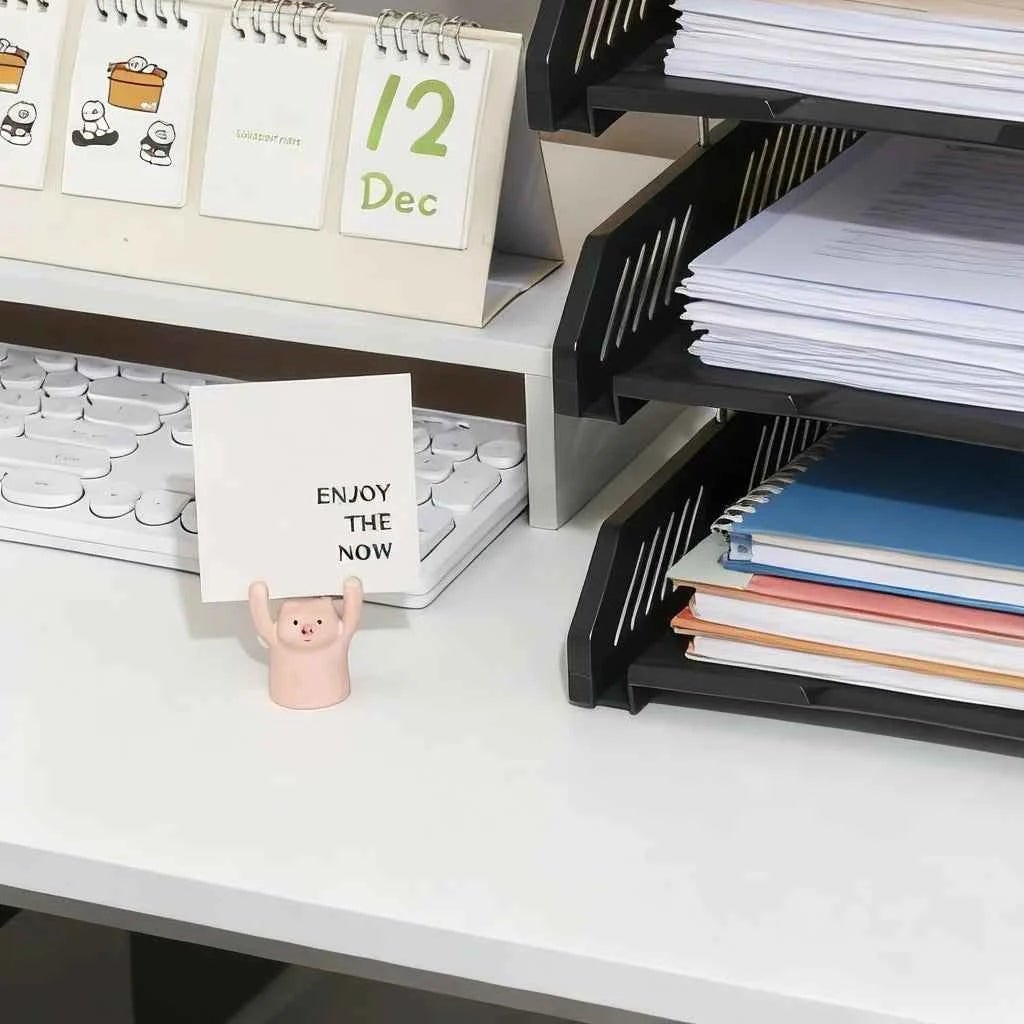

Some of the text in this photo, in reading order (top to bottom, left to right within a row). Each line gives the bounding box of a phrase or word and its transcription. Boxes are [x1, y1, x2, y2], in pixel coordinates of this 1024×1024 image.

[367, 73, 455, 157] 12
[361, 171, 438, 216] Dec
[317, 483, 391, 504] ENJOY
[343, 512, 392, 532] THE
[338, 542, 392, 562] NOW
